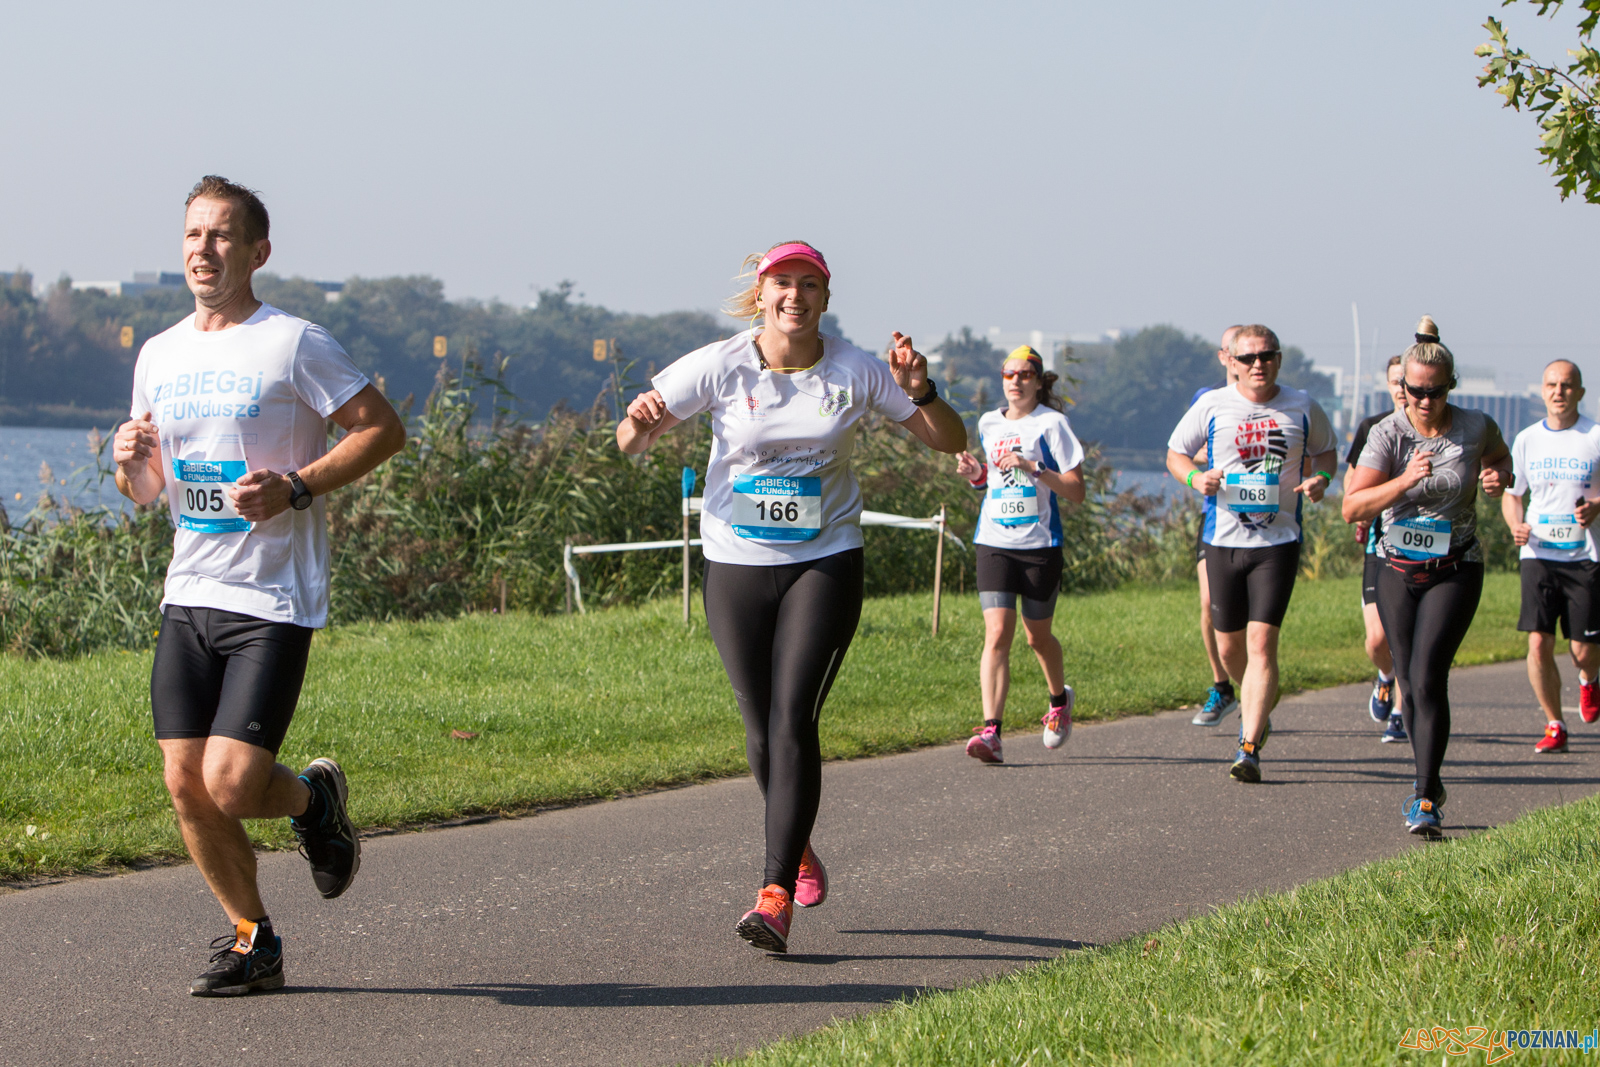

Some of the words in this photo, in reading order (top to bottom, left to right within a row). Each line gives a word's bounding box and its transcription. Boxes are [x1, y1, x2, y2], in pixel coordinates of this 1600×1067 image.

[154, 370, 263, 403] zaBIEGaj
[162, 400, 260, 422] FUNdusze
[1235, 430, 1266, 446] CZE
[1237, 445, 1266, 460] WO
[183, 463, 222, 475] zaBIEGaj
[1529, 458, 1593, 473] zaBIEGaj
[188, 473, 222, 481] FUNdusze
[1537, 471, 1592, 481] FUNdusze
[755, 478, 800, 489] zaBIEGaj
[762, 487, 800, 495] FUNdusze
[1239, 488, 1266, 501] 068
[186, 488, 224, 512] 005
[756, 500, 799, 522] 166
[1001, 501, 1025, 514] 056
[1403, 531, 1434, 548] 090
[1549, 527, 1572, 538] 467
